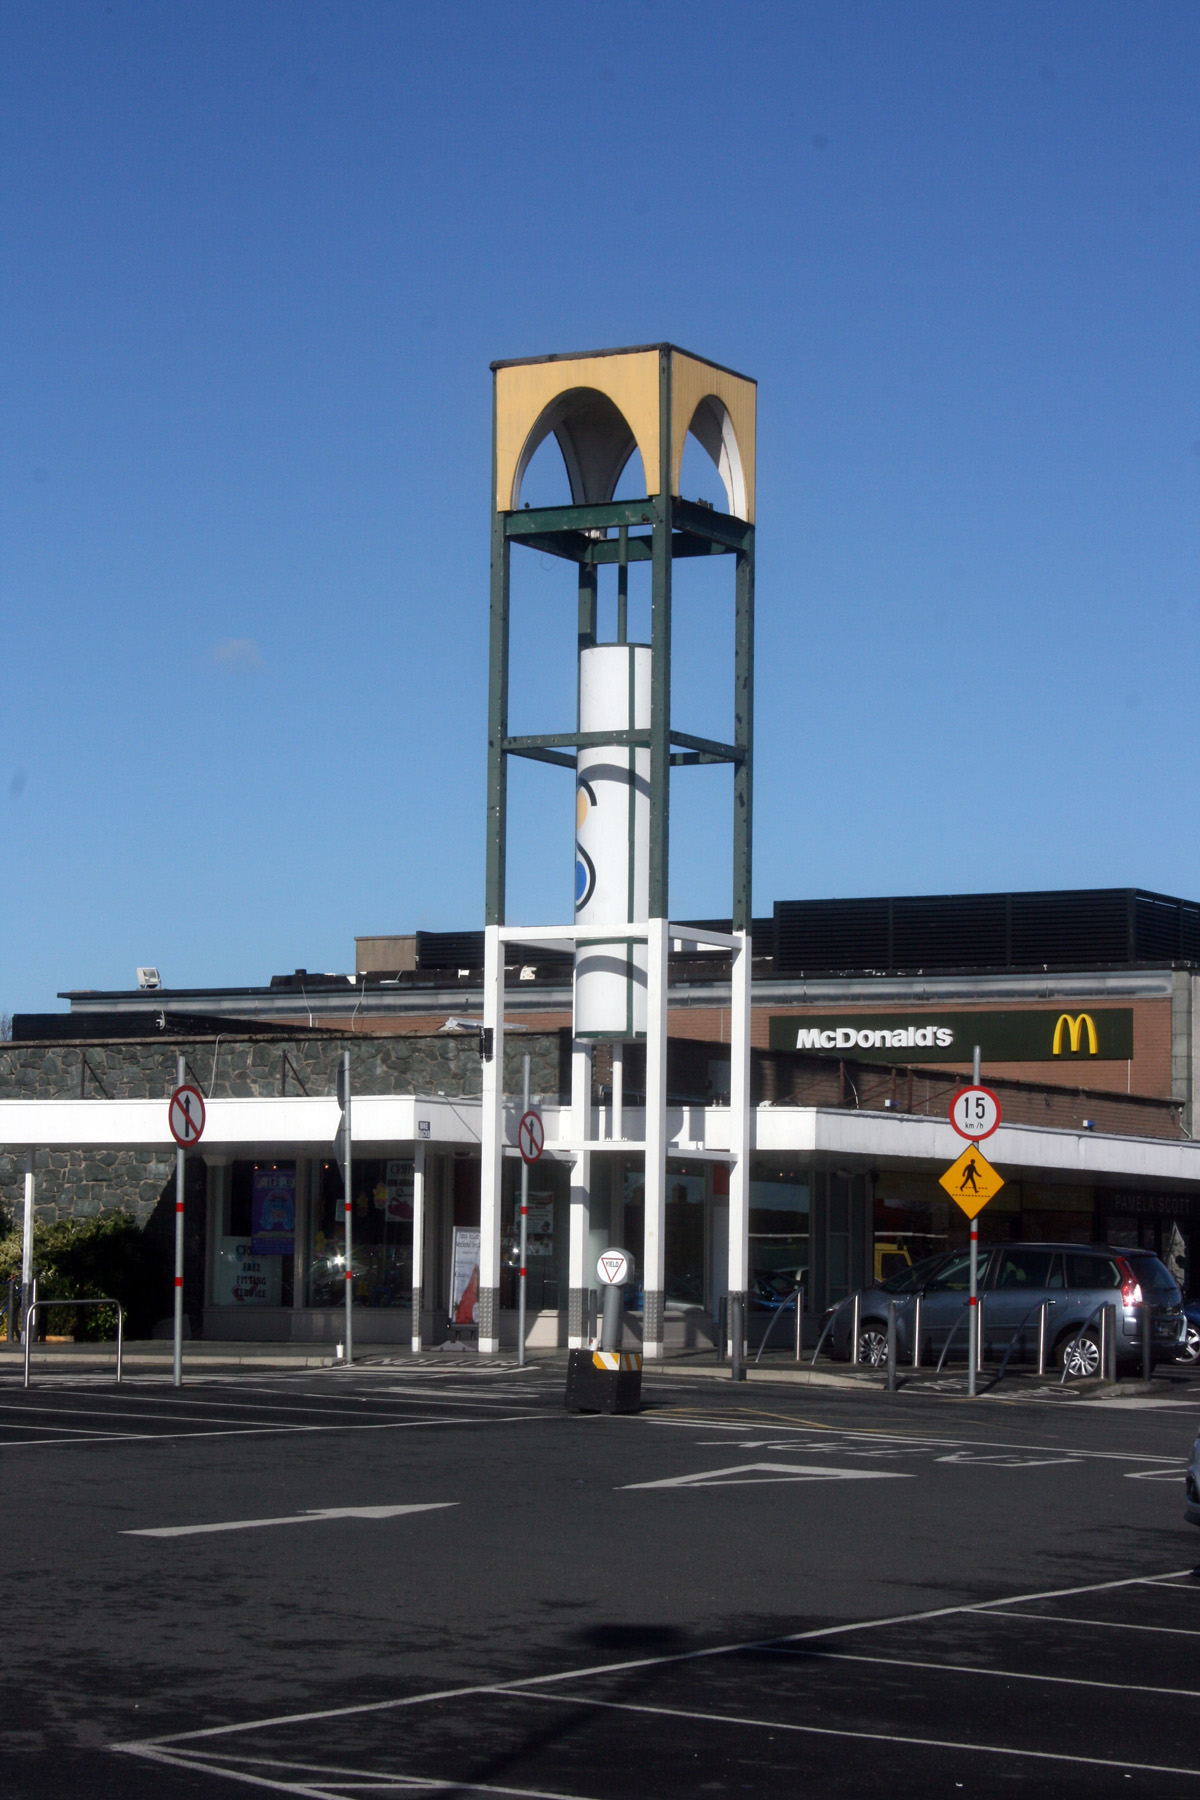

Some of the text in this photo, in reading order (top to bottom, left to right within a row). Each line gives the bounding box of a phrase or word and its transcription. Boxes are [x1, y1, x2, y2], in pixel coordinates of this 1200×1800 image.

[796, 1026, 954, 1049] McDonald's
[964, 1097, 986, 1119] 15
[1114, 1193, 1191, 1216] PAMELA SCOTT
[242, 1262, 261, 1272] FREE
[236, 1275, 267, 1285] FITTING
[235, 1287, 266, 1298] SERVICE
